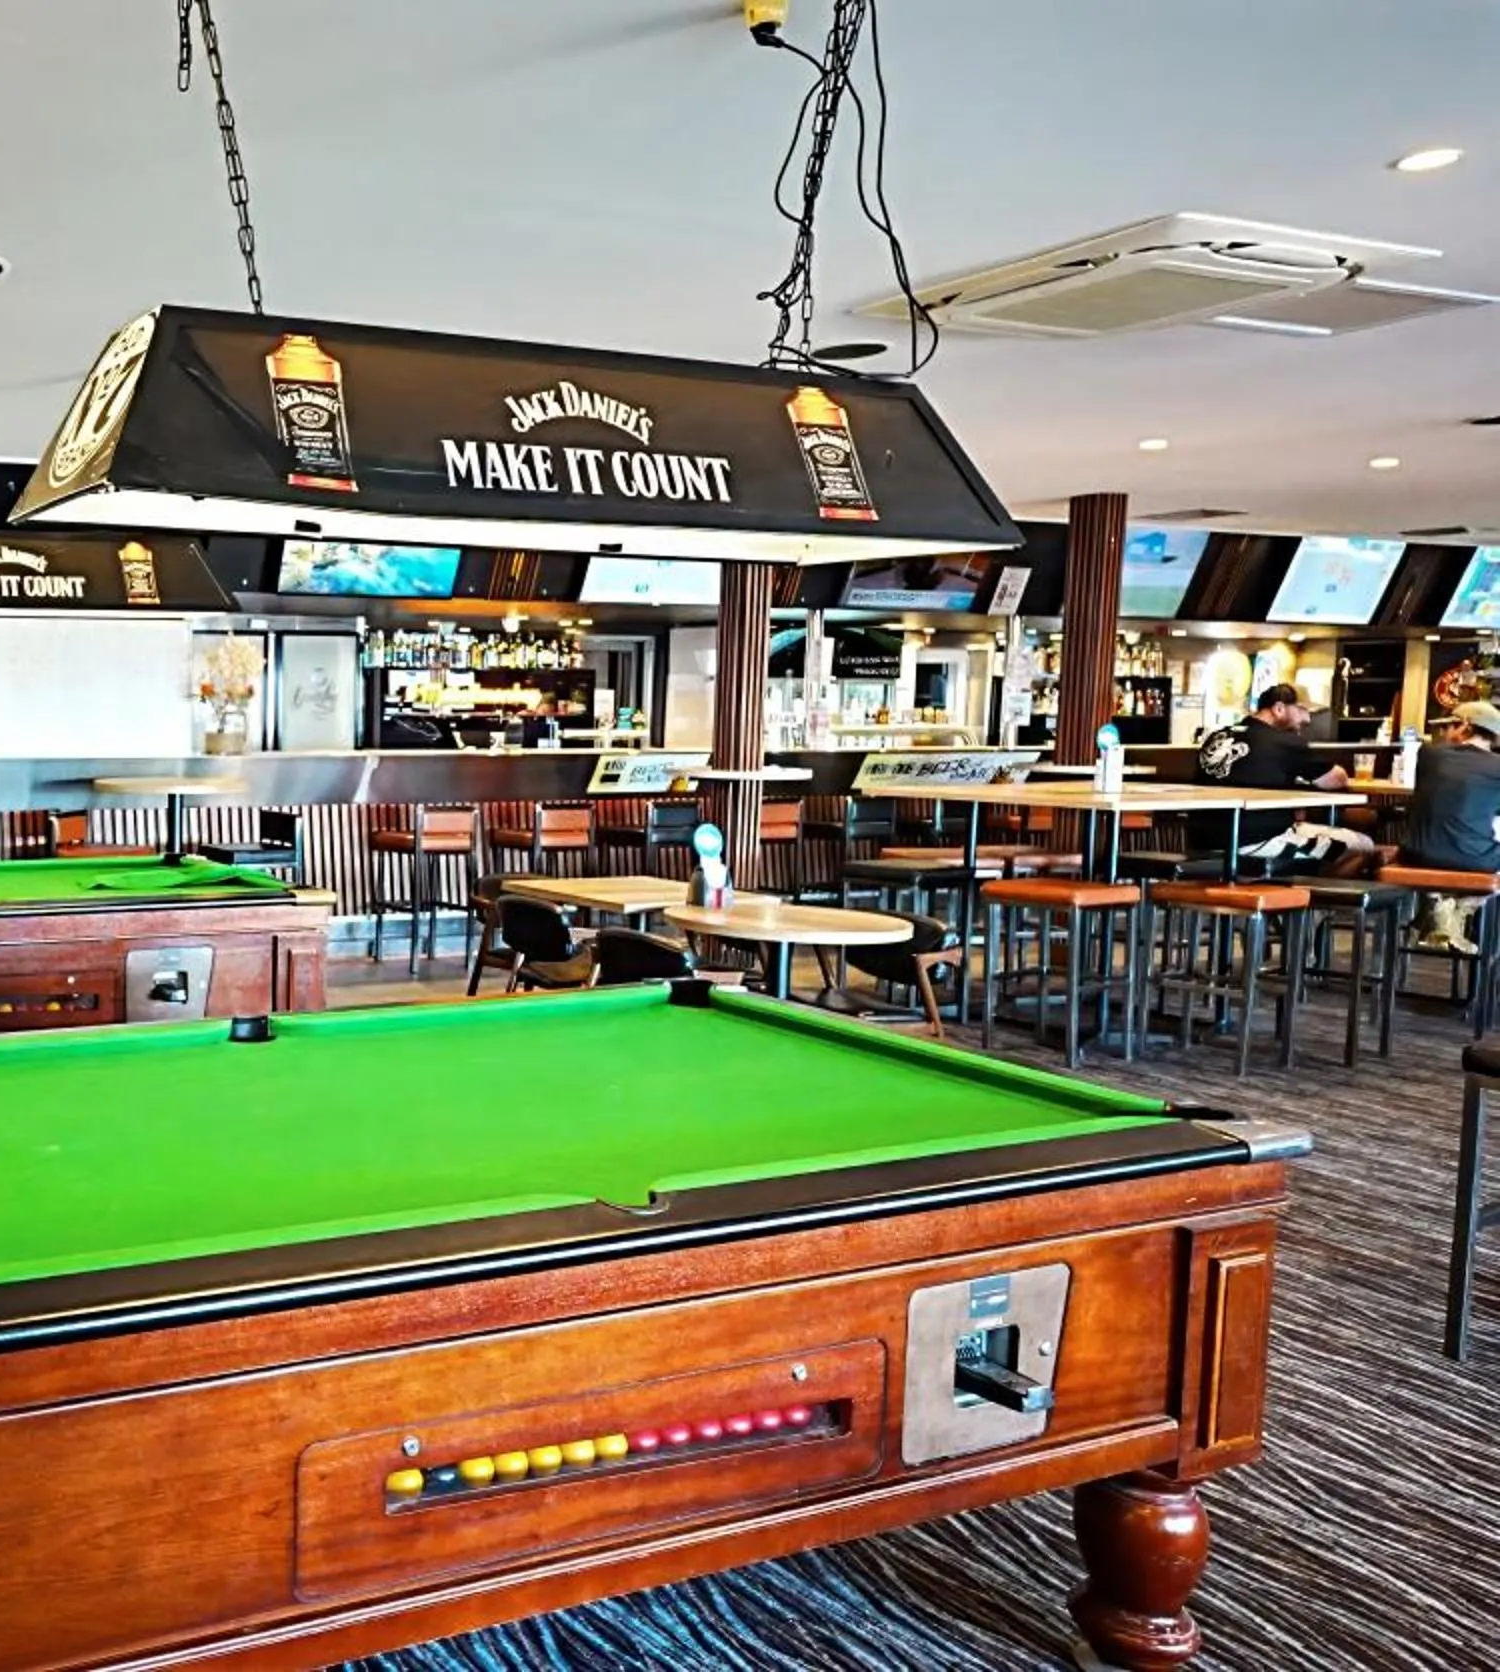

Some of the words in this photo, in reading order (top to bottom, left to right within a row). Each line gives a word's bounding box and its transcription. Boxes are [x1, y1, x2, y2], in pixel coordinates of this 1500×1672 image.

[504, 390, 564, 432] JACK
[559, 381, 653, 446] DANIEL'S
[441, 439, 559, 493] MAKE
[563, 447, 605, 495] IT
[611, 450, 732, 503] COUNT
[0, 575, 20, 597] IT
[23, 575, 86, 598] COUNT
